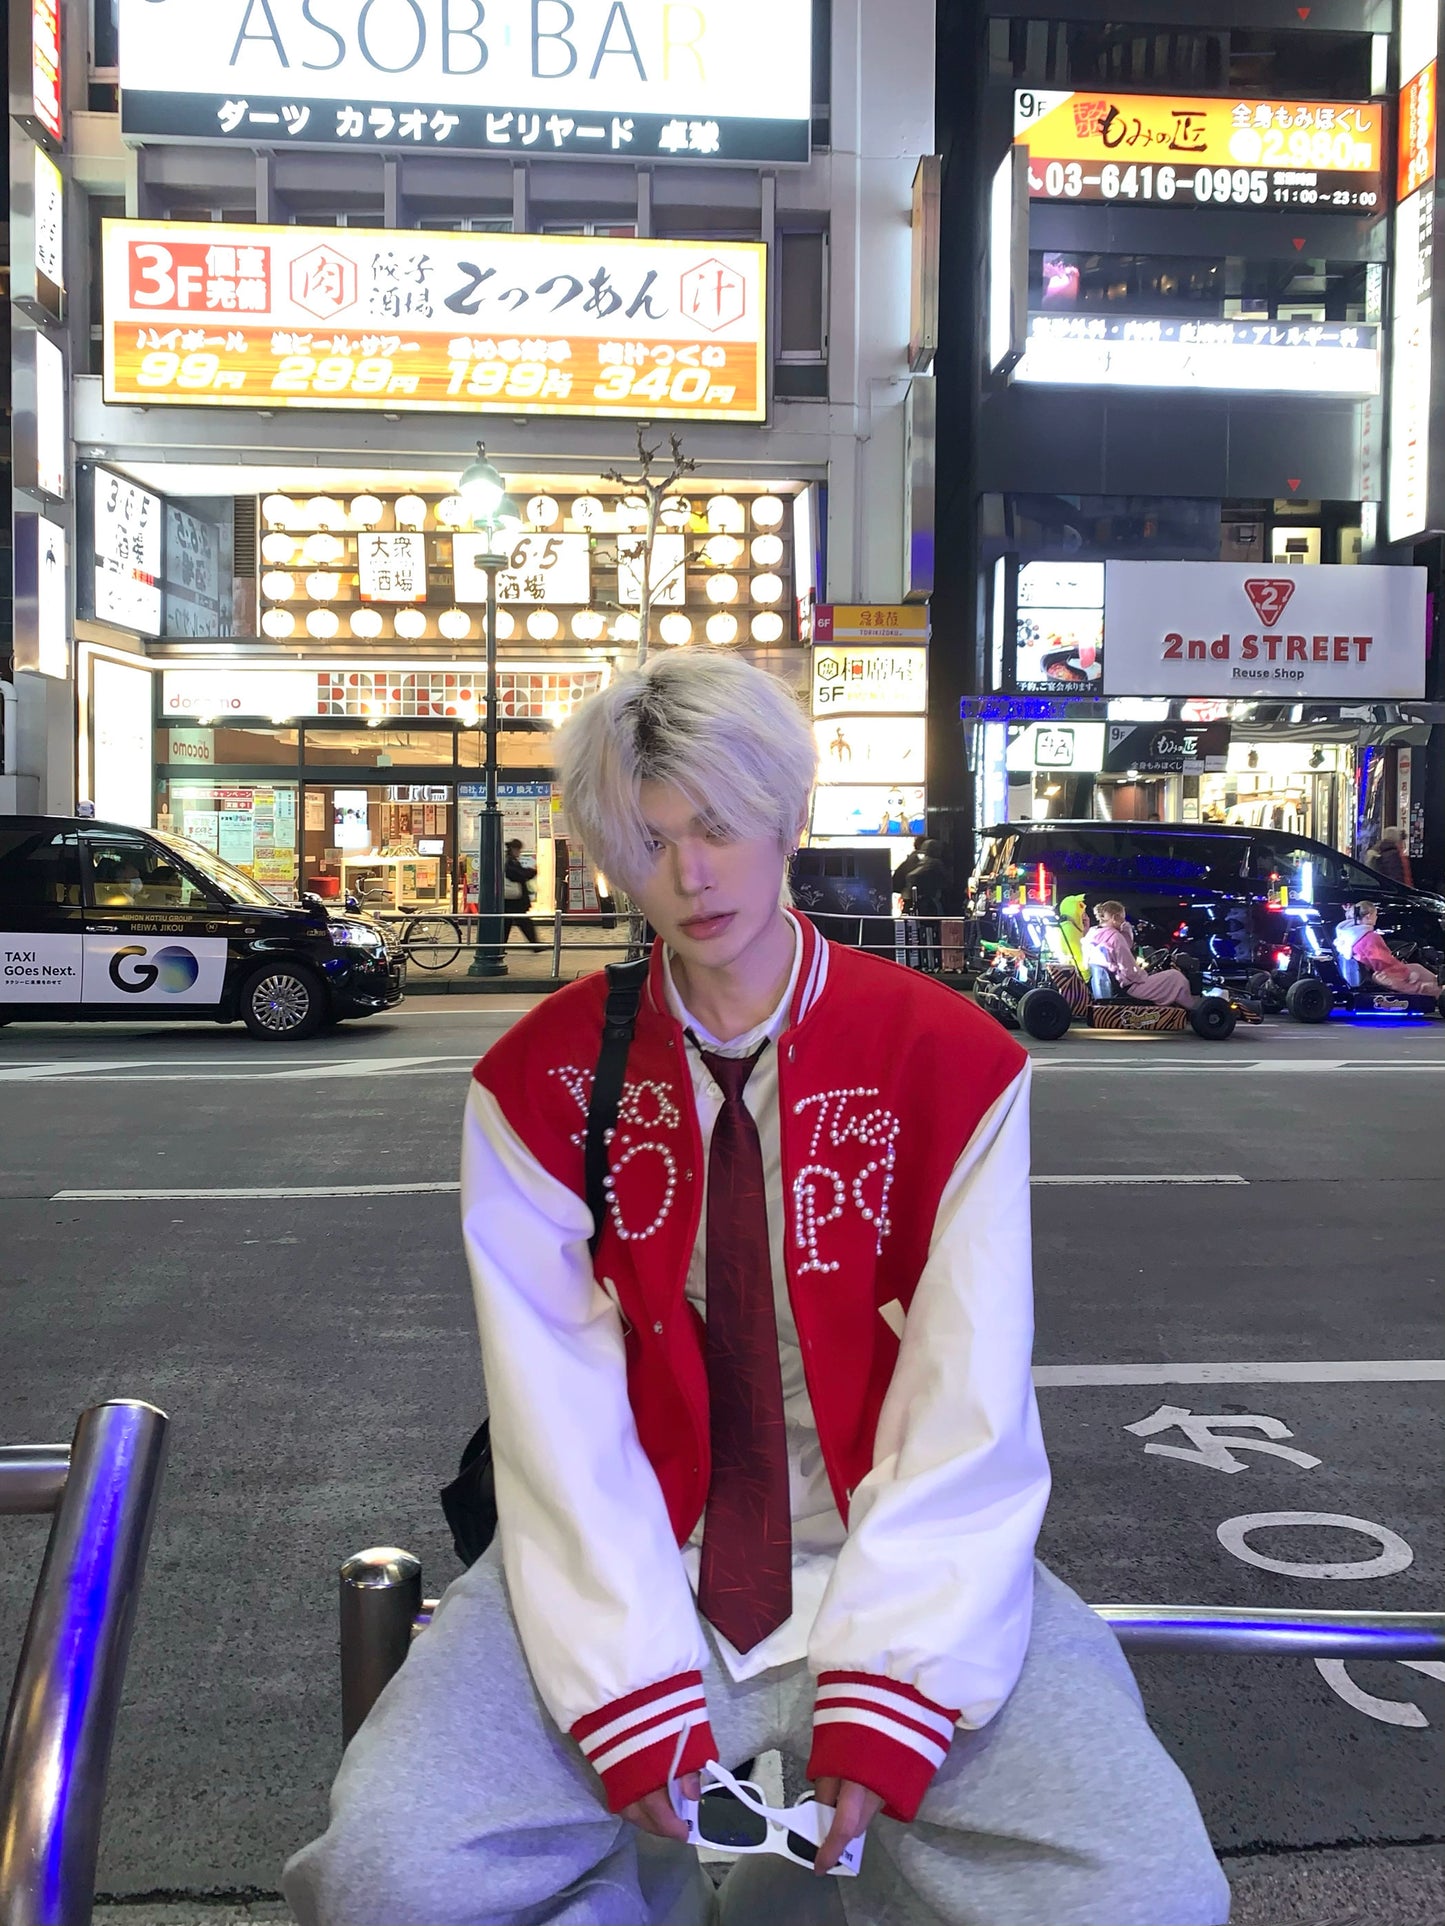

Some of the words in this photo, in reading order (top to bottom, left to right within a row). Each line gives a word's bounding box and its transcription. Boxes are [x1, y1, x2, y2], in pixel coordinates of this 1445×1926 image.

[217, 99, 310, 135] ダーツ
[336, 105, 459, 142] カラオケ
[486, 111, 634, 150] ビリヤード
[1098, 104, 1207, 152] もみの匠
[1231, 102, 1372, 133] 全身もみほぐし
[1045, 161, 1268, 204] 03-6416-0995
[134, 244, 203, 308] 3F
[136, 328, 249, 353] ハイボール
[136, 352, 247, 390] 99円
[270, 356, 421, 394] 299円
[593, 365, 736, 404] 340円
[817, 618, 831, 628] 6F
[1162, 633, 1231, 661] 2nd
[1241, 635, 1374, 663] STREET
[1232, 667, 1269, 680] Reuse
[1274, 668, 1305, 682] Shop
[819, 686, 846, 703] 5F
[130, 923, 158, 932] HEIWA
[160, 924, 184, 933] JIKOU
[4, 965, 39, 977] GOes
[42, 965, 77, 977] Next.
[5, 952, 36, 962] TAXI
